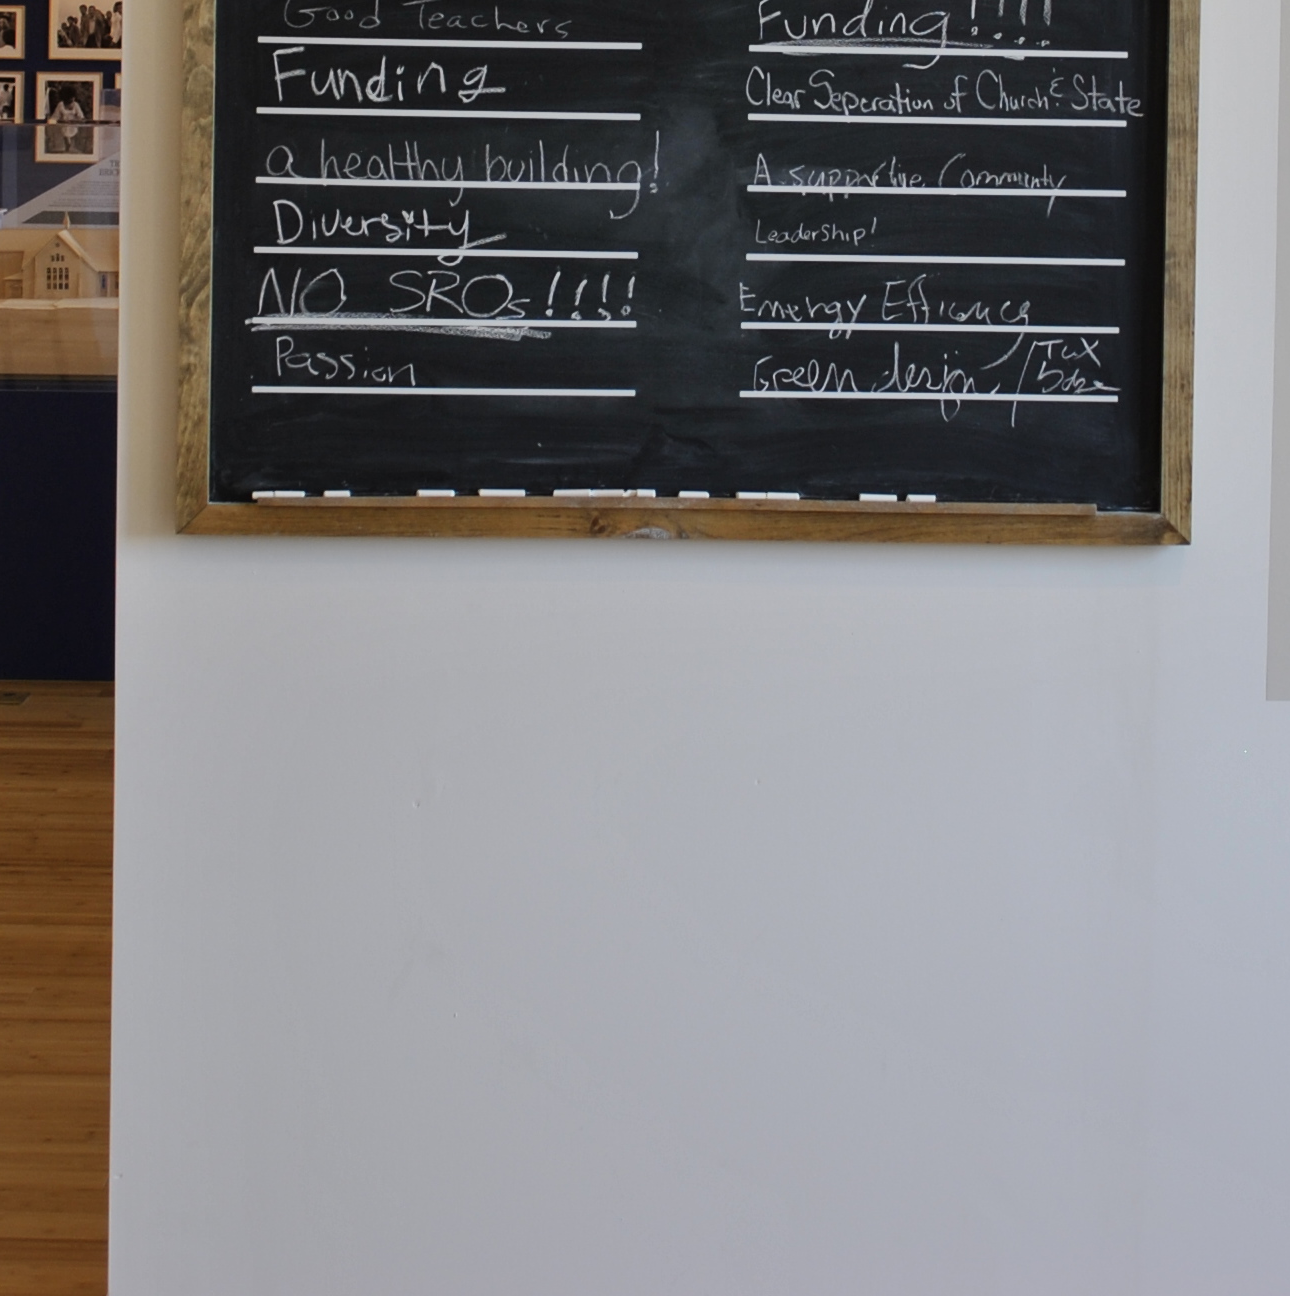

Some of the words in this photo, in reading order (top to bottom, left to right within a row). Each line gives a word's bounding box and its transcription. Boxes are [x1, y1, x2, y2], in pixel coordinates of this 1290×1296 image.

[273, 47, 506, 103] Funding
[746, 65, 806, 109] Clear
[944, 75, 968, 113] of
[976, 69, 1049, 112] Church
[1071, 73, 1144, 117] State
[266, 145, 296, 177] a
[320, 139, 464, 206] healthy
[485, 130, 660, 219] building!
[754, 153, 772, 186] A
[273, 200, 507, 266] Diversity
[257, 268, 347, 317] NO
[276, 336, 416, 386] Passion
[754, 355, 859, 393] Green
